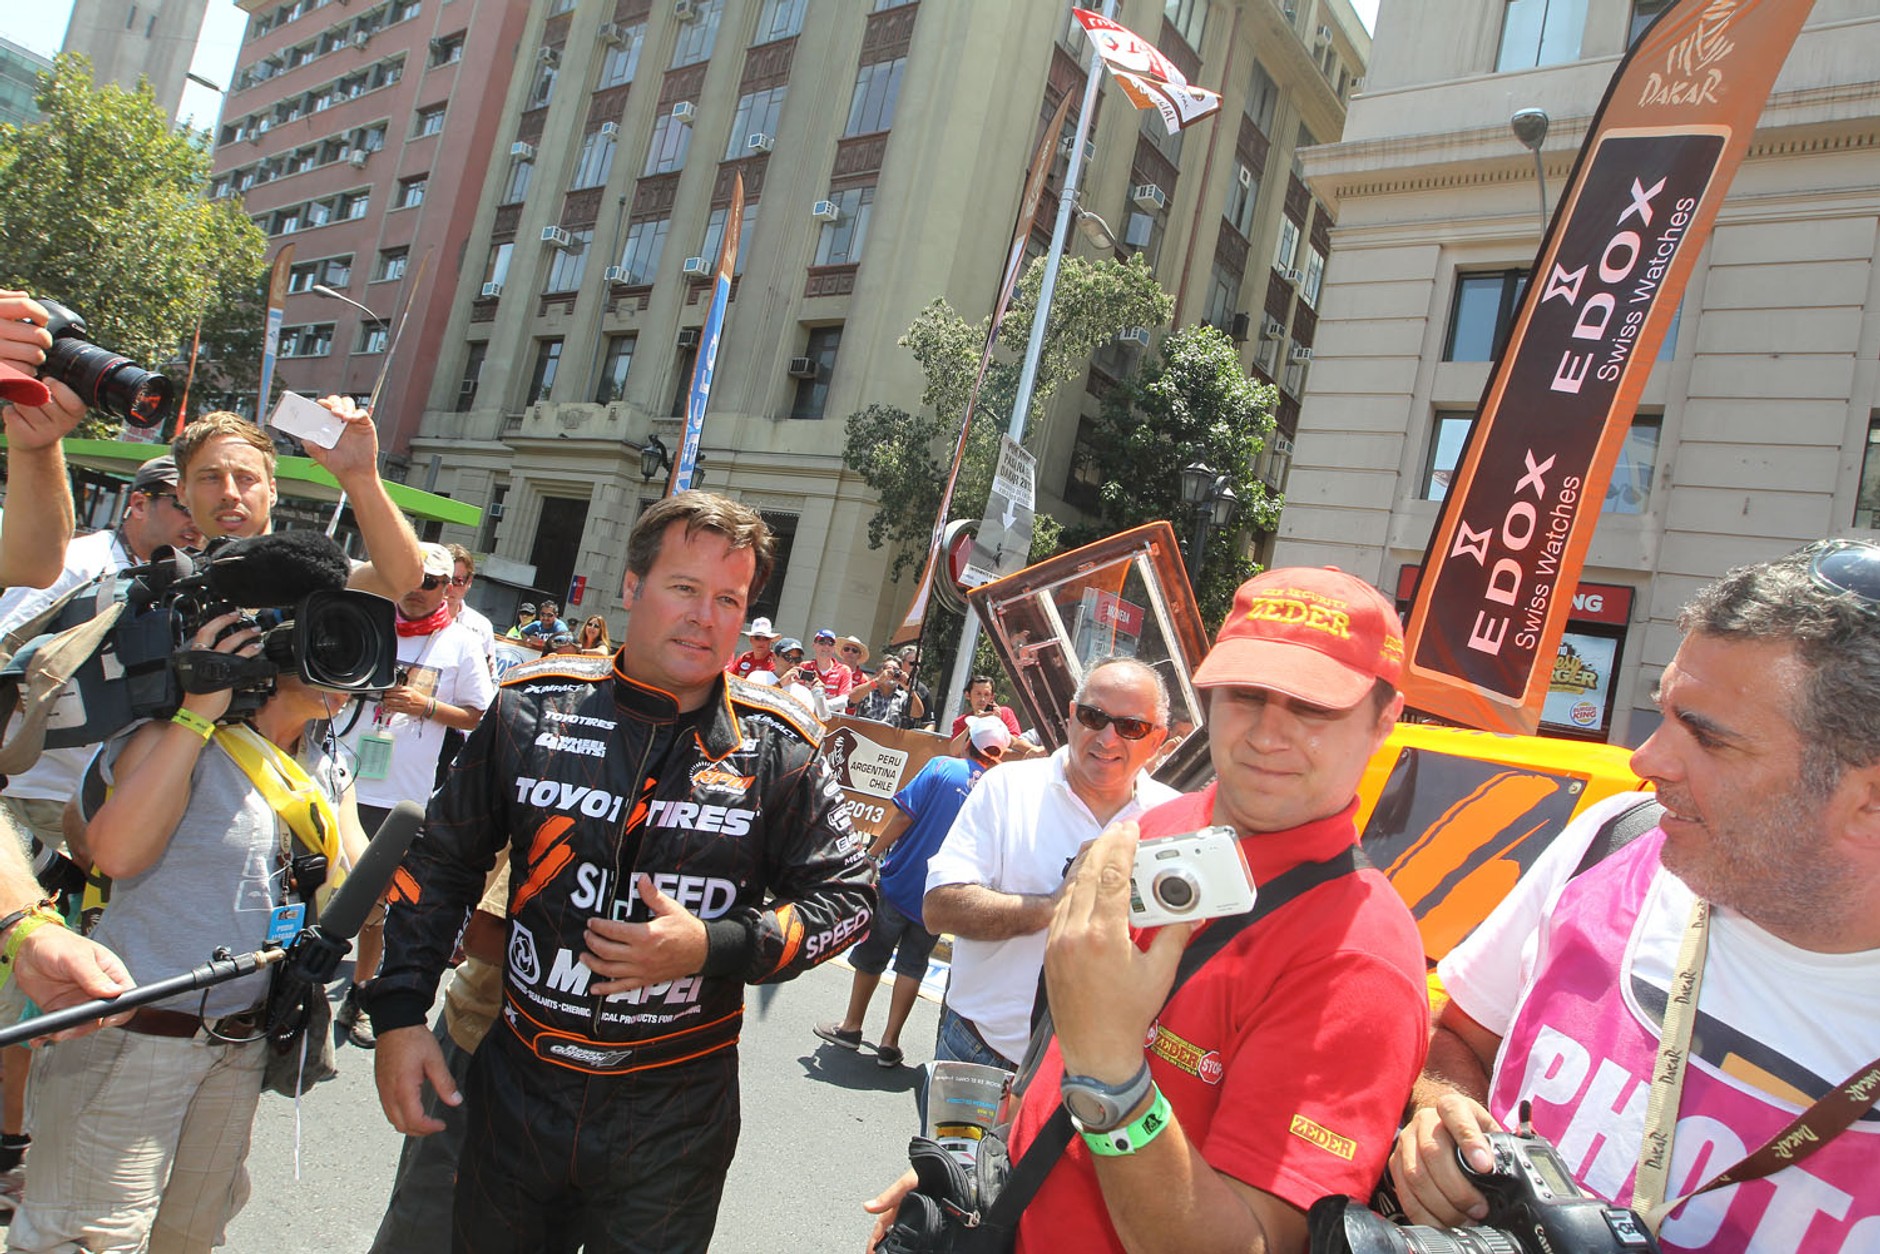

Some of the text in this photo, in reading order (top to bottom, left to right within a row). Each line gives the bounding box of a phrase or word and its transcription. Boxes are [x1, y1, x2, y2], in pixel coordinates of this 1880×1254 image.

[1638, 68, 1722, 108] DAKAR
[1551, 176, 1668, 394] EDOX
[1597, 197, 1695, 381] Swiss Watches
[1467, 448, 1557, 656] EDOX
[1515, 475, 1580, 650] Swiss Watches
[1247, 597, 1351, 639] ZEDER
[1572, 594, 1604, 612] NG
[850, 762, 896, 779] ARGENTINA
[877, 754, 901, 767] PERU
[869, 778, 893, 792] CHILE
[646, 800, 756, 836] TIRES
[846, 800, 885, 823] 2013
[806, 909, 870, 959] SPEED
[1674, 970, 1696, 1005] DAKAR
[1155, 1033, 1200, 1070] ZEDER
[1202, 1058, 1223, 1075] STOP
[1659, 1049, 1683, 1085] DAKAR
[1293, 1116, 1353, 1158] ZEDER
[1503, 1024, 1880, 1254] PHOT
[1645, 1131, 1669, 1170] DAKAR
[1772, 1124, 1819, 1158] DAKAR
[1534, 1223, 1556, 1254] Can
